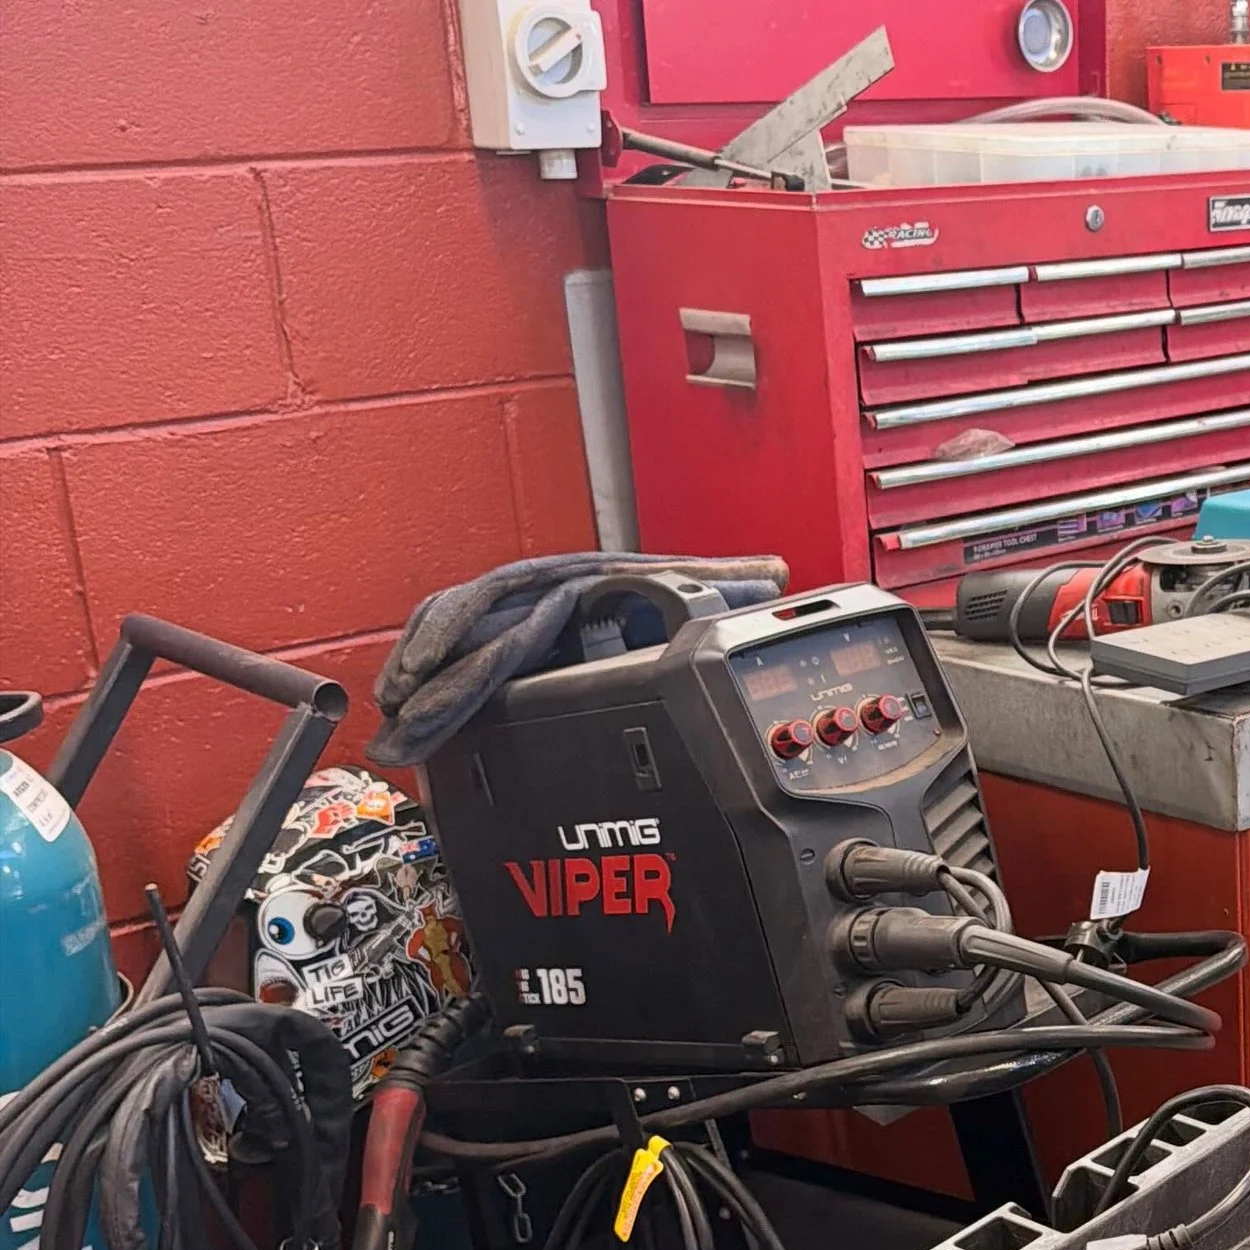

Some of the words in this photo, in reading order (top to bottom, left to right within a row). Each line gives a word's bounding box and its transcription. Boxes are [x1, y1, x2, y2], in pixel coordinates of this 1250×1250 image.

[503, 852, 676, 936] VIPER
[307, 958, 346, 984] TIG
[535, 967, 587, 1006] 185
[311, 982, 359, 1005] LIFE
